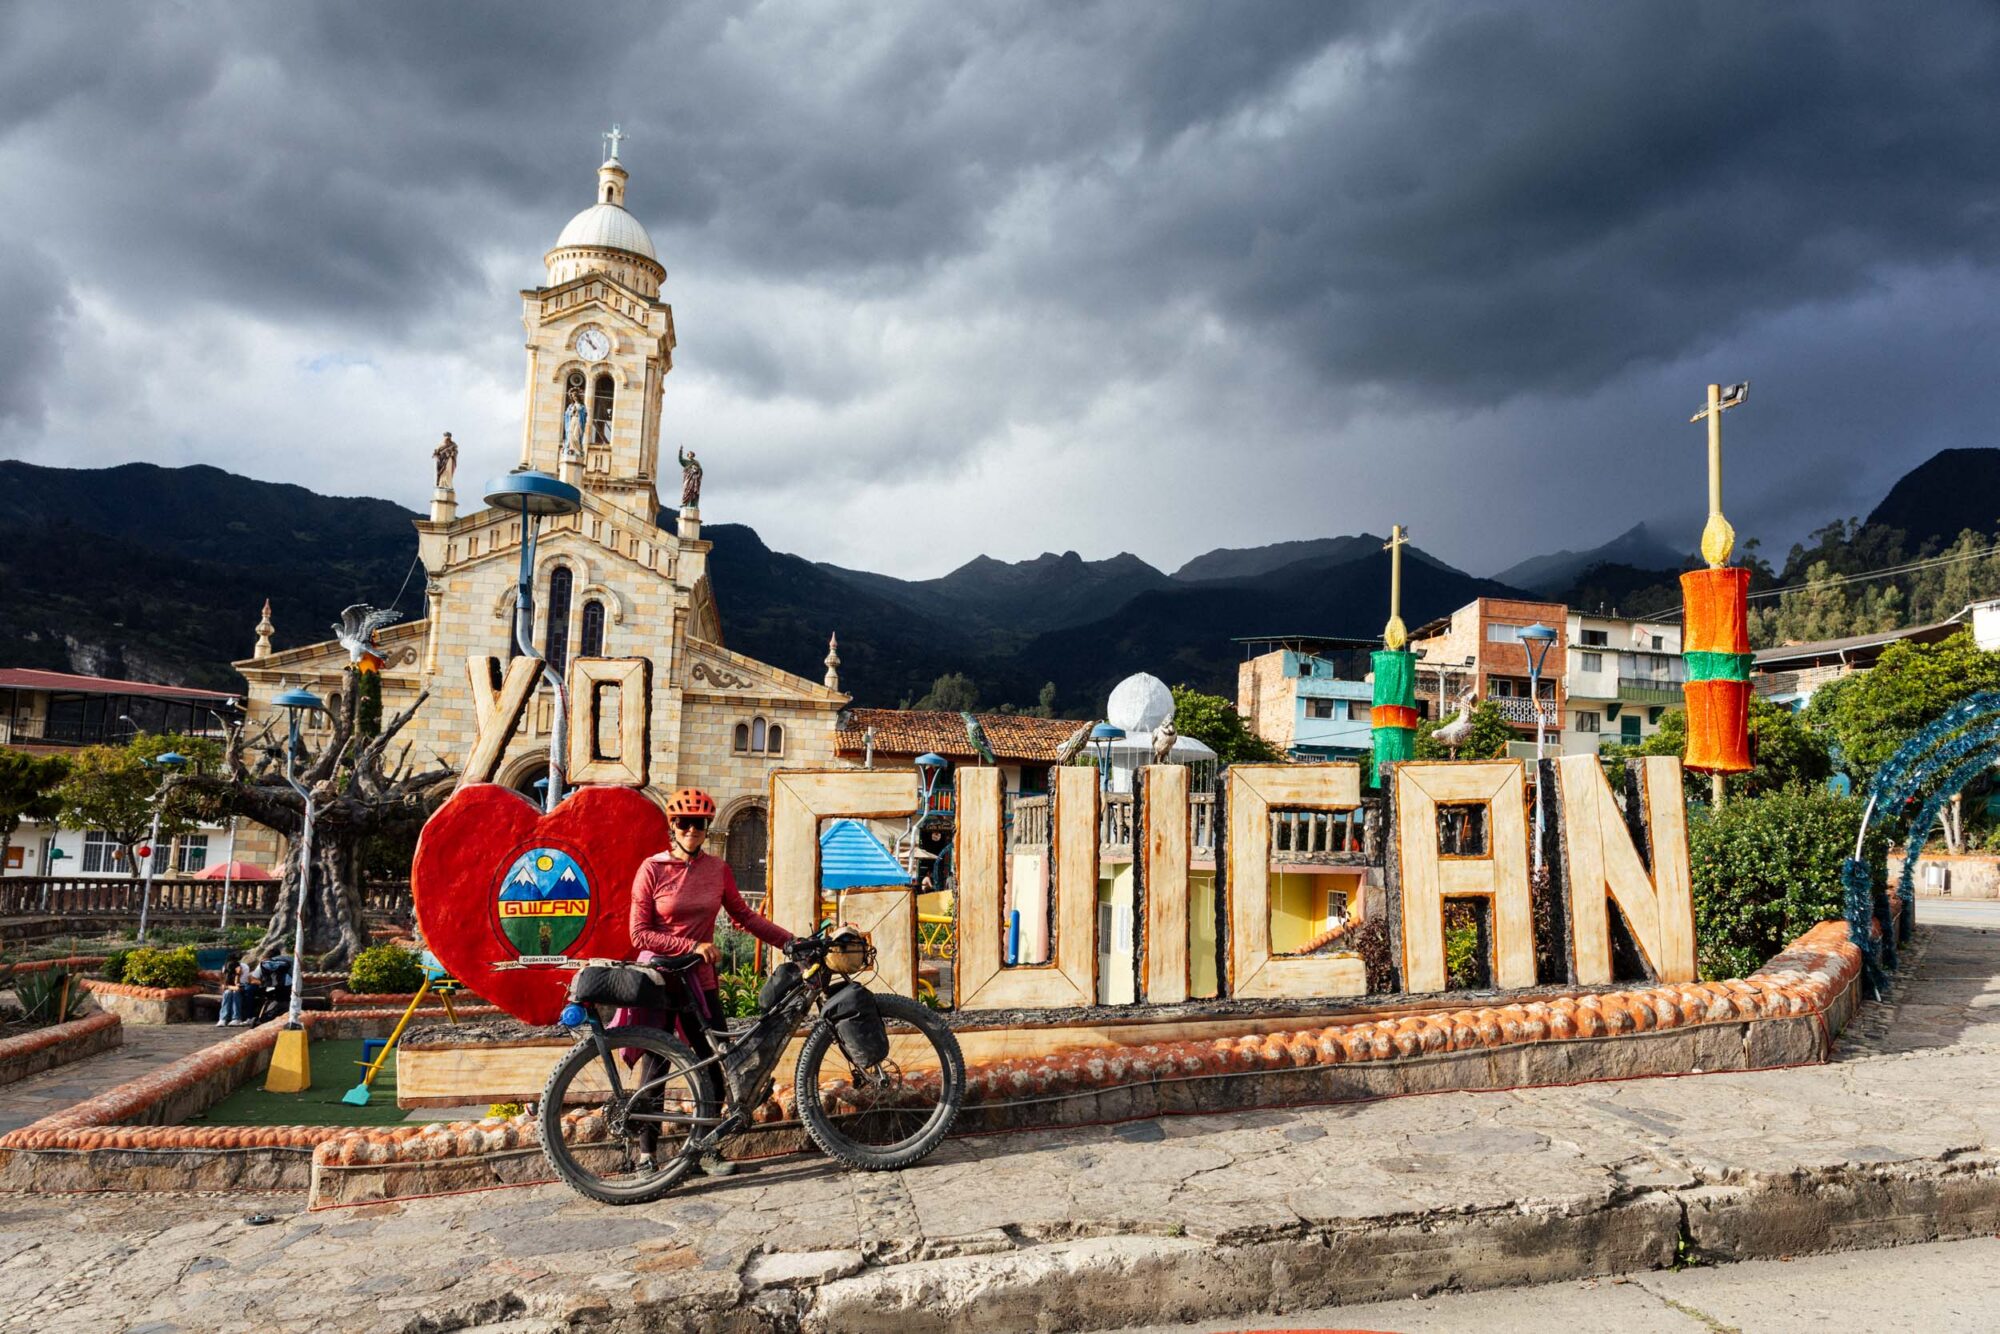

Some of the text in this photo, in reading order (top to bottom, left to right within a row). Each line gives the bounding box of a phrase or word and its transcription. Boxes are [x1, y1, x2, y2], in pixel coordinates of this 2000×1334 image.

[457, 655, 652, 787] YO
[505, 901, 585, 914] GUICAN
[767, 752, 1698, 1012] GUICAN
